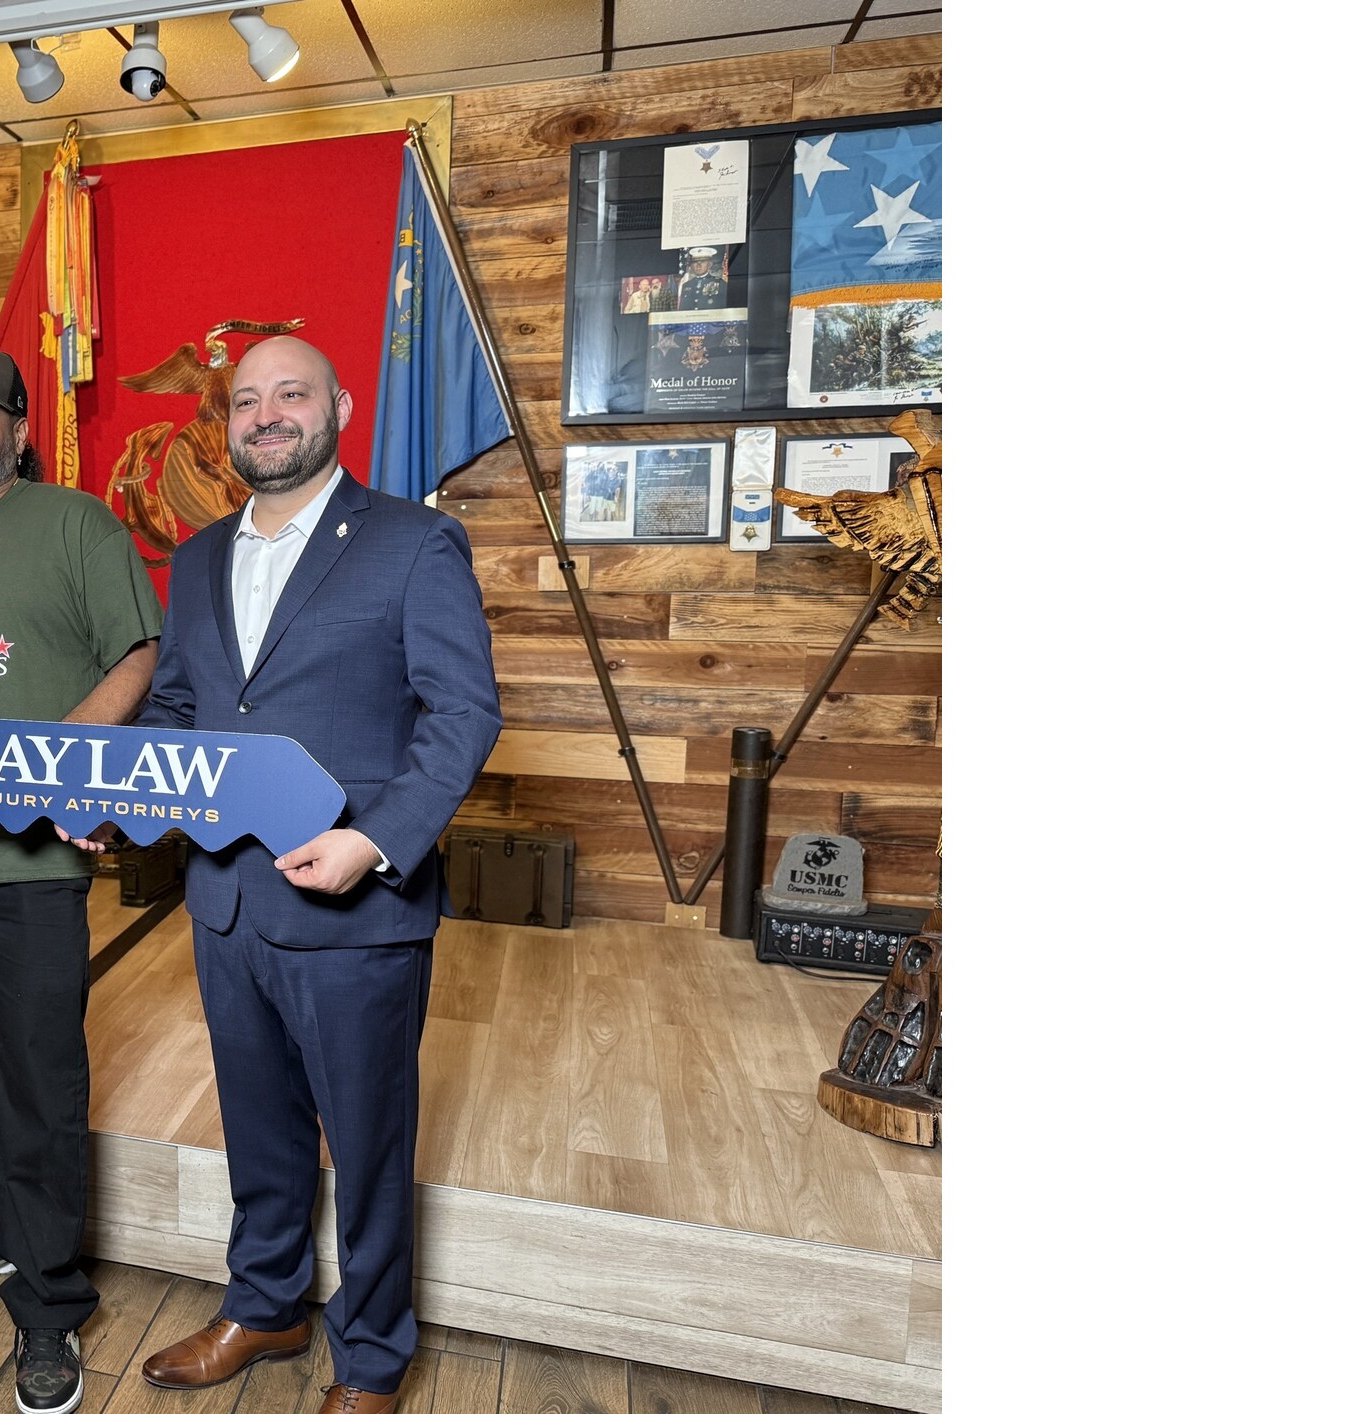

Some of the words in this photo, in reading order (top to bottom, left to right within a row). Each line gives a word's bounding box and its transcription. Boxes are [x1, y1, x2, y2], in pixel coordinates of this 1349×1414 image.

[254, 323, 287, 332] FIDELIS
[650, 377, 684, 388] Medal
[687, 376, 700, 387] of
[701, 376, 737, 387] Honor
[63, 413, 78, 480] CORPS
[84, 738, 238, 798] LAW
[65, 798, 219, 823] ATTORNEYS
[790, 869, 848, 888] USMC
[787, 883, 816, 895] Semper
[818, 887, 846, 897] Fidelis
